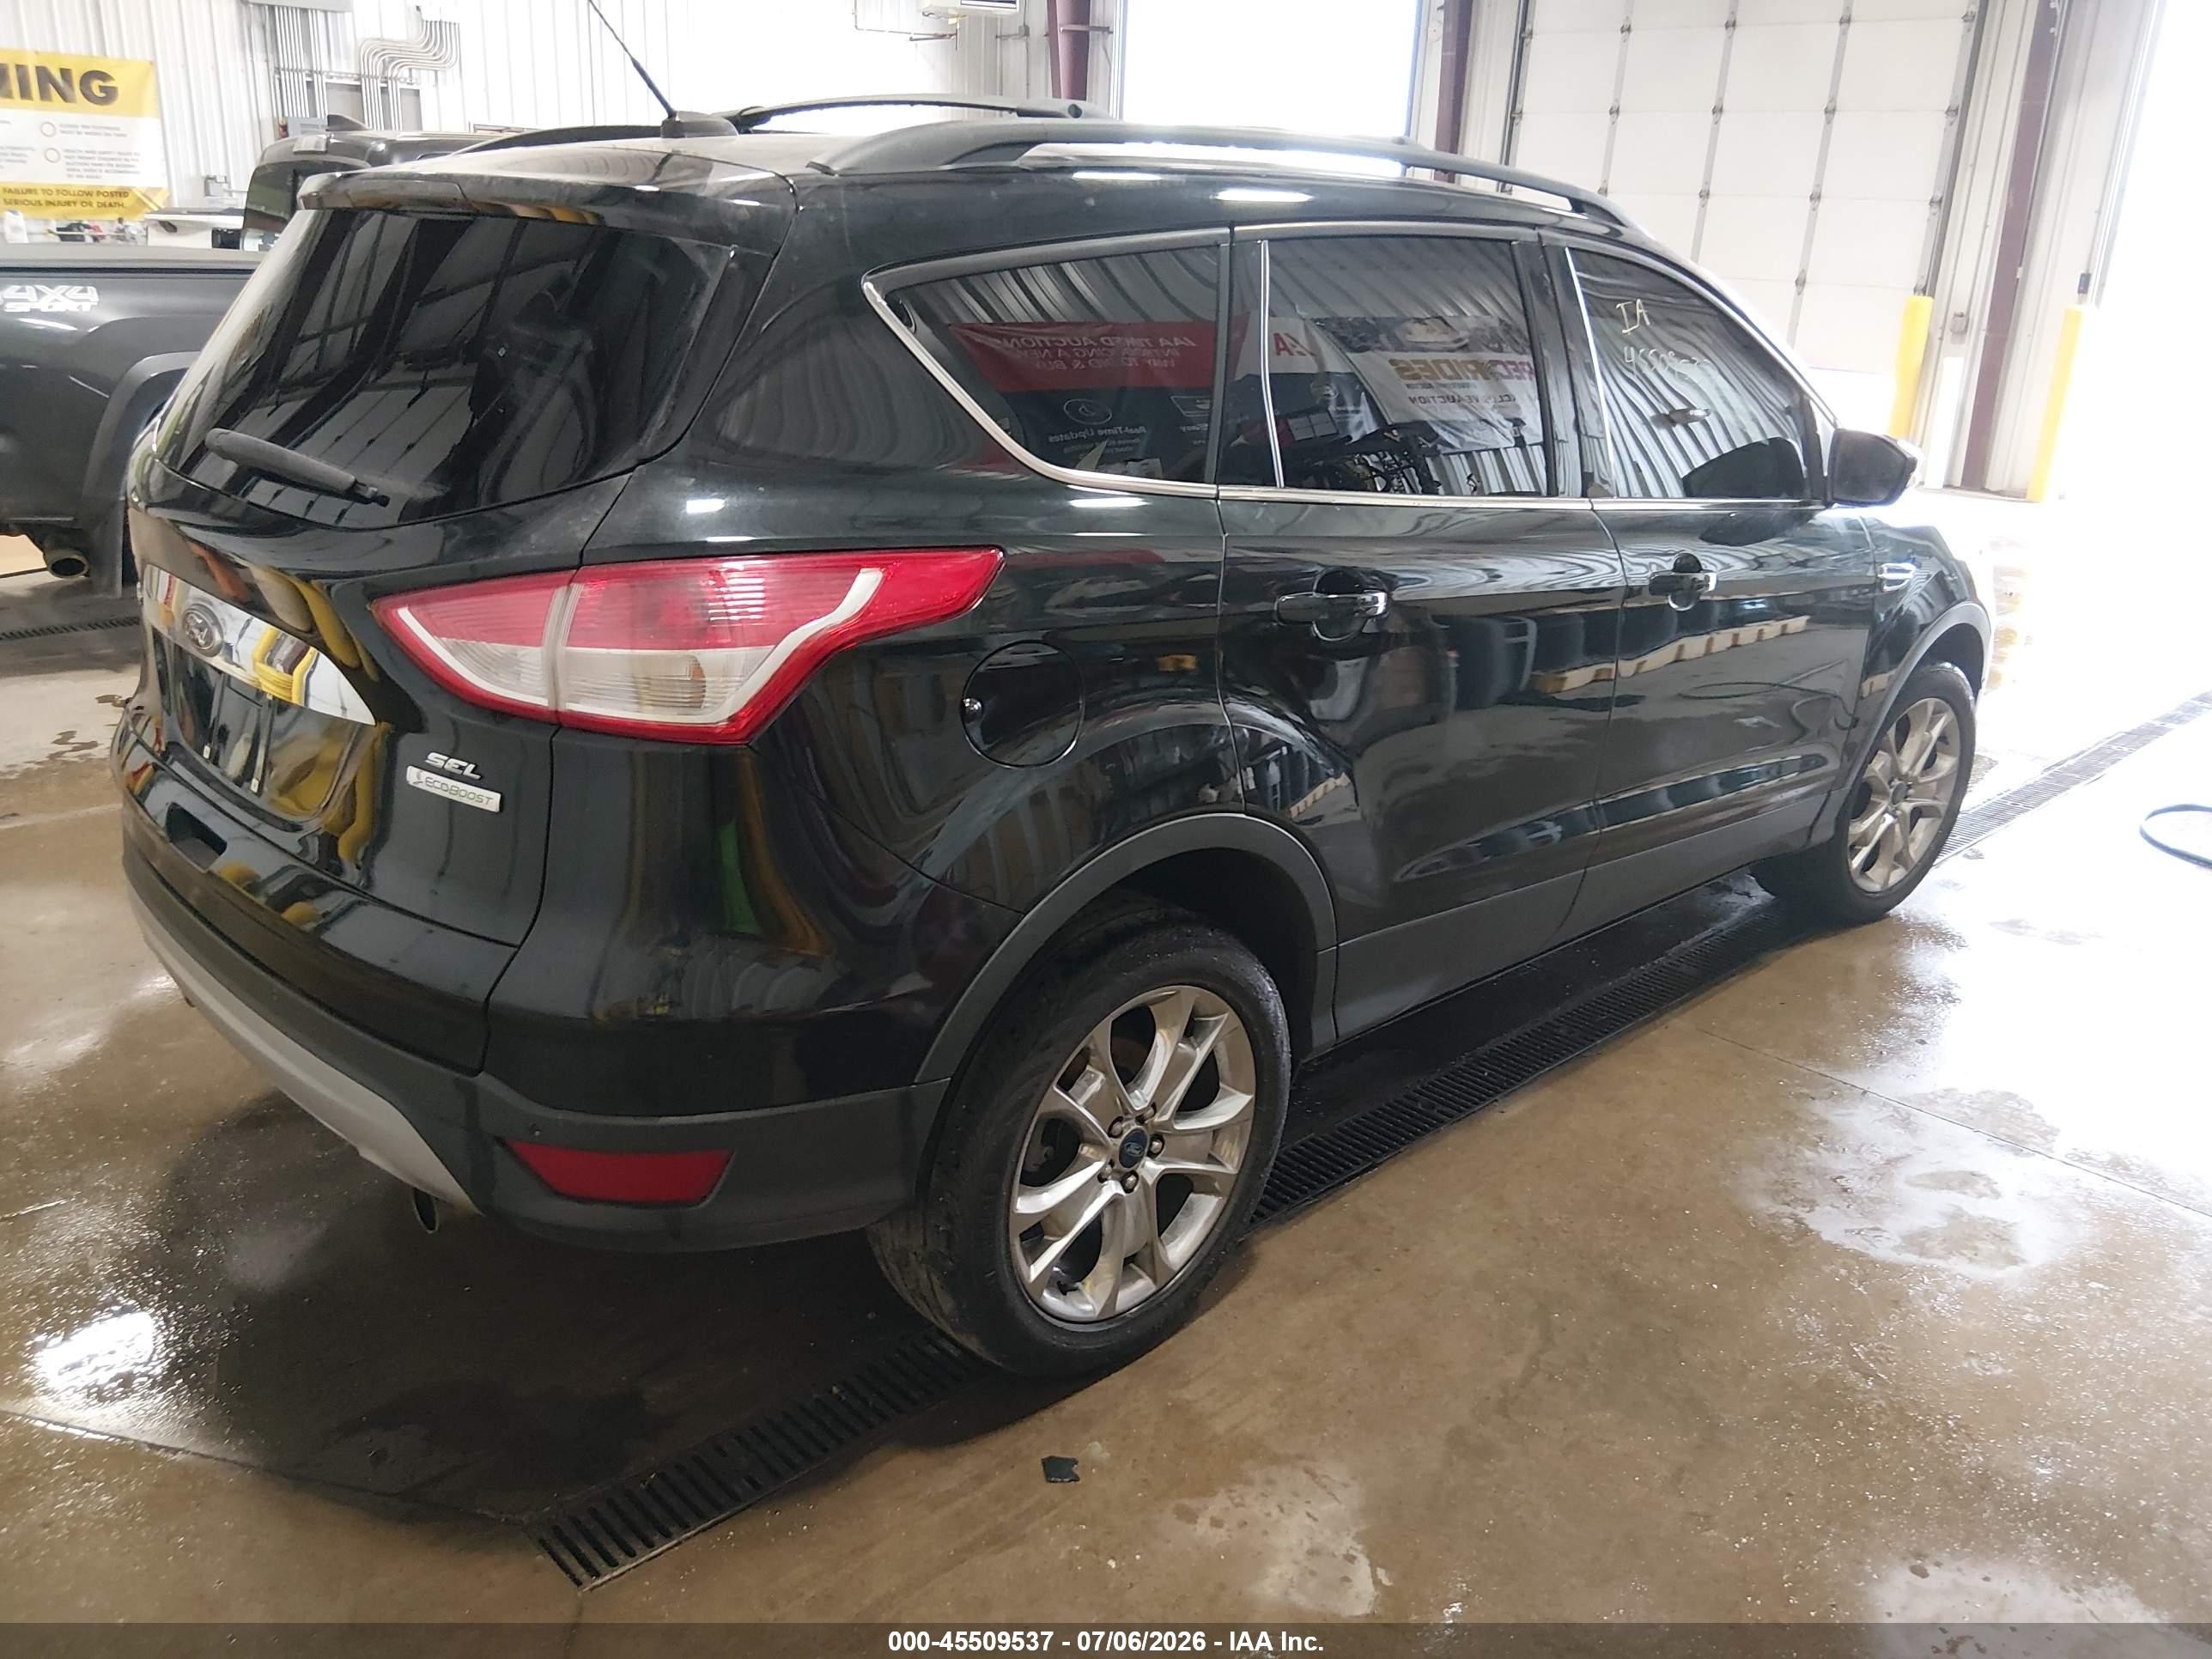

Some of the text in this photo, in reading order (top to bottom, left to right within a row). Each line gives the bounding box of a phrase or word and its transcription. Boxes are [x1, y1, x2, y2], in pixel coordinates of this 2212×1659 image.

[3, 187, 39, 196] FAILURE
[41, 188, 54, 197] TO
[56, 189, 94, 198] FOLLOW
[3, 198, 43, 207] SERIOUS
[424, 751, 482, 781] SEL
[424, 776, 495, 805] ECOBOOST
